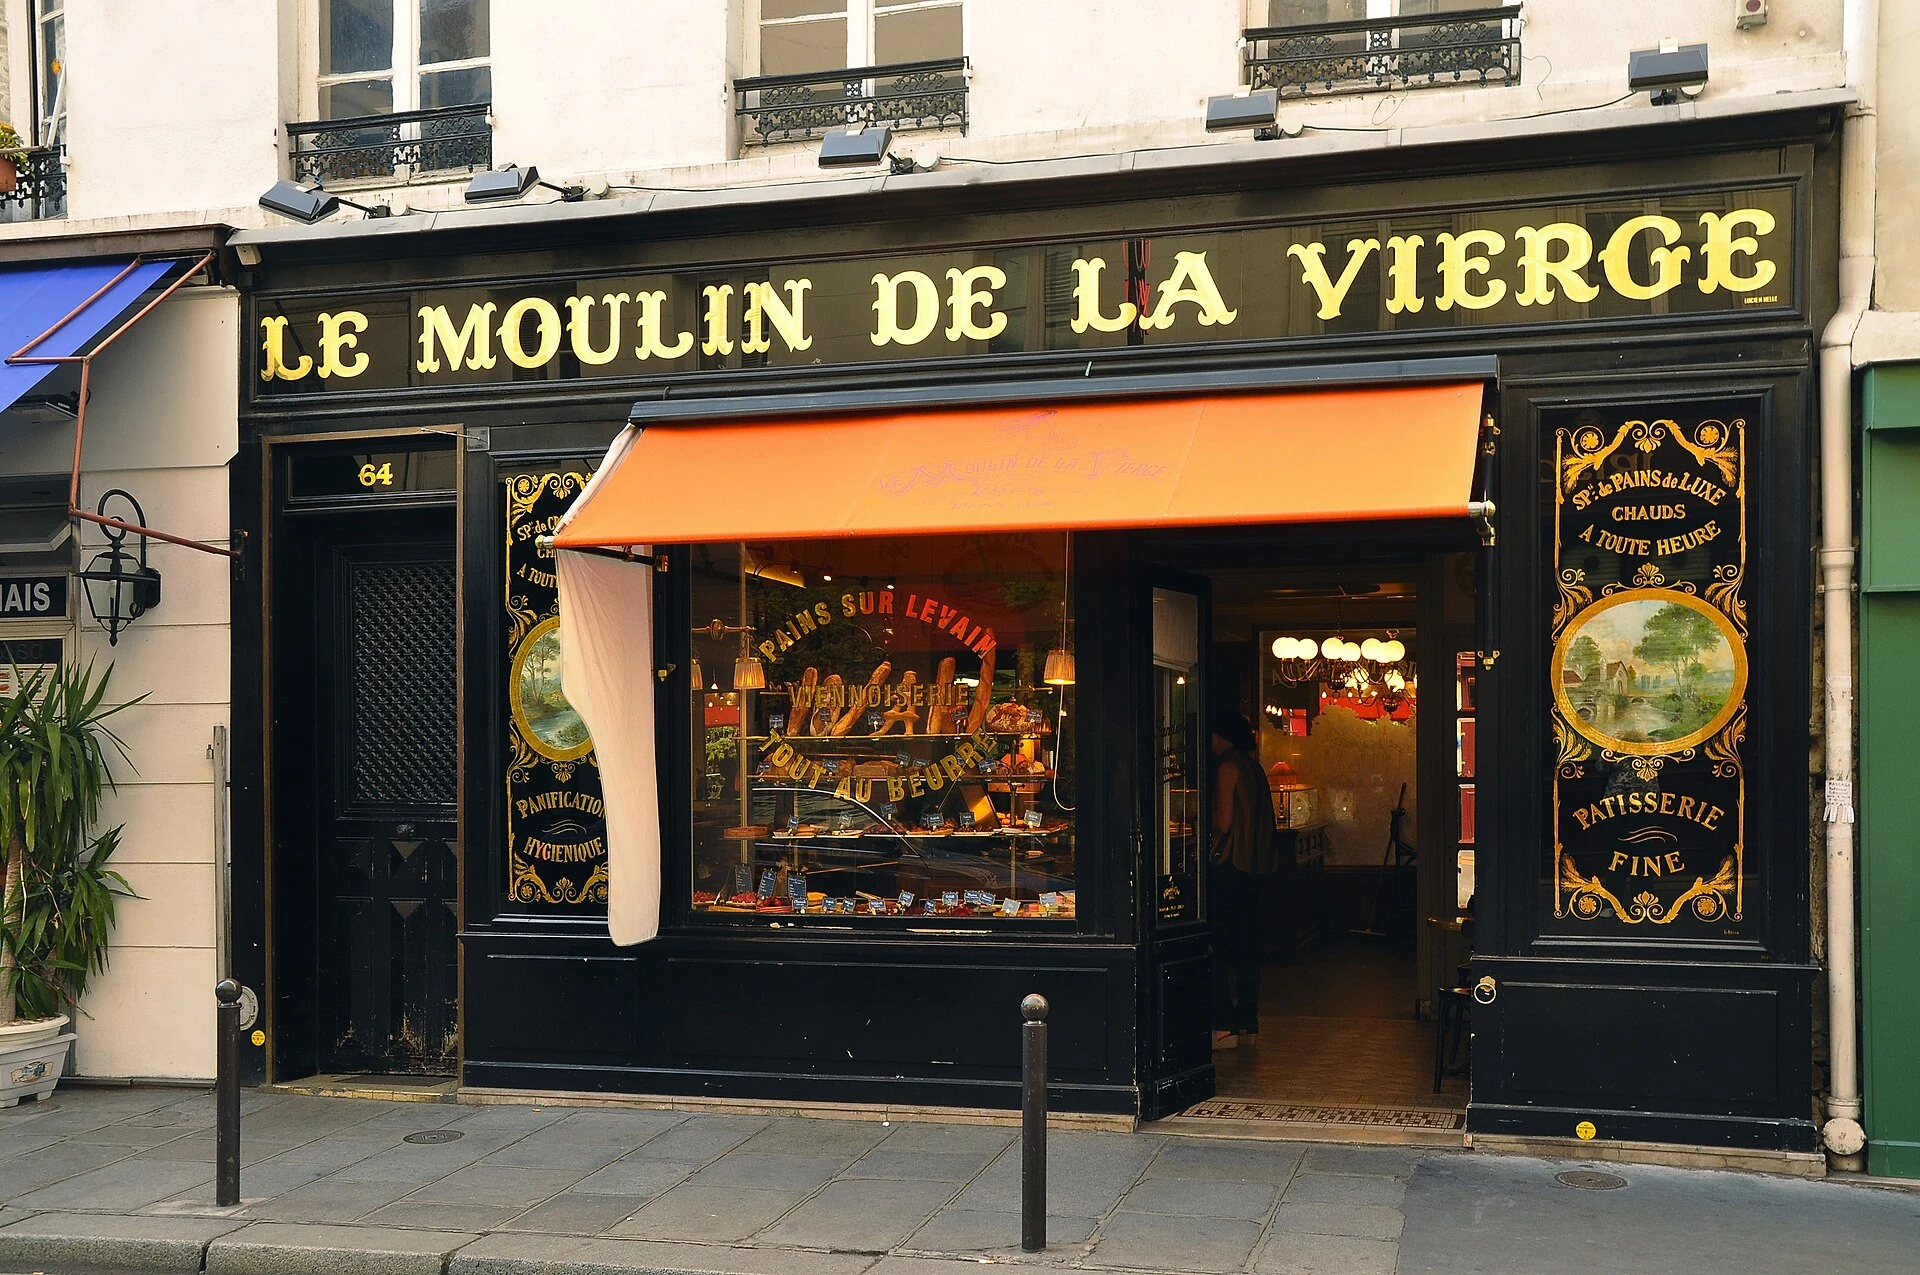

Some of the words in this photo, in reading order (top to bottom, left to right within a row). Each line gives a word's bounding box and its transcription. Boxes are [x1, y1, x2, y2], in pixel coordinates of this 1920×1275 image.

[260, 311, 370, 382] LE
[416, 278, 813, 374] MOULIN
[870, 265, 1008, 348] DE
[1071, 249, 1238, 334] LA
[1286, 208, 1777, 321] VIERGE
[358, 462, 394, 487] 64
[1610, 470, 1661, 492] PAINS
[1662, 473, 1677, 489] de
[1678, 472, 1727, 507] LUXE
[1611, 504, 1686, 521] CHAUDS
[1578, 524, 1595, 542] A
[1595, 530, 1650, 556] TOUTE
[1657, 520, 1722, 556] HEURE
[516, 563, 527, 578] A
[0, 582, 50, 611] AIS
[758, 602, 831, 663] PAINS
[842, 590, 893, 618] SUR
[906, 594, 997, 659] LEVAIN
[788, 683, 970, 708] VIENNOISERIE
[758, 728, 827, 790] TOUT
[834, 776, 873, 803] AU
[888, 727, 998, 803] BEURRE
[1572, 791, 1724, 831] PATISSERIE
[523, 836, 606, 863] HYGIENIQUE
[1607, 851, 1685, 877] FINE
